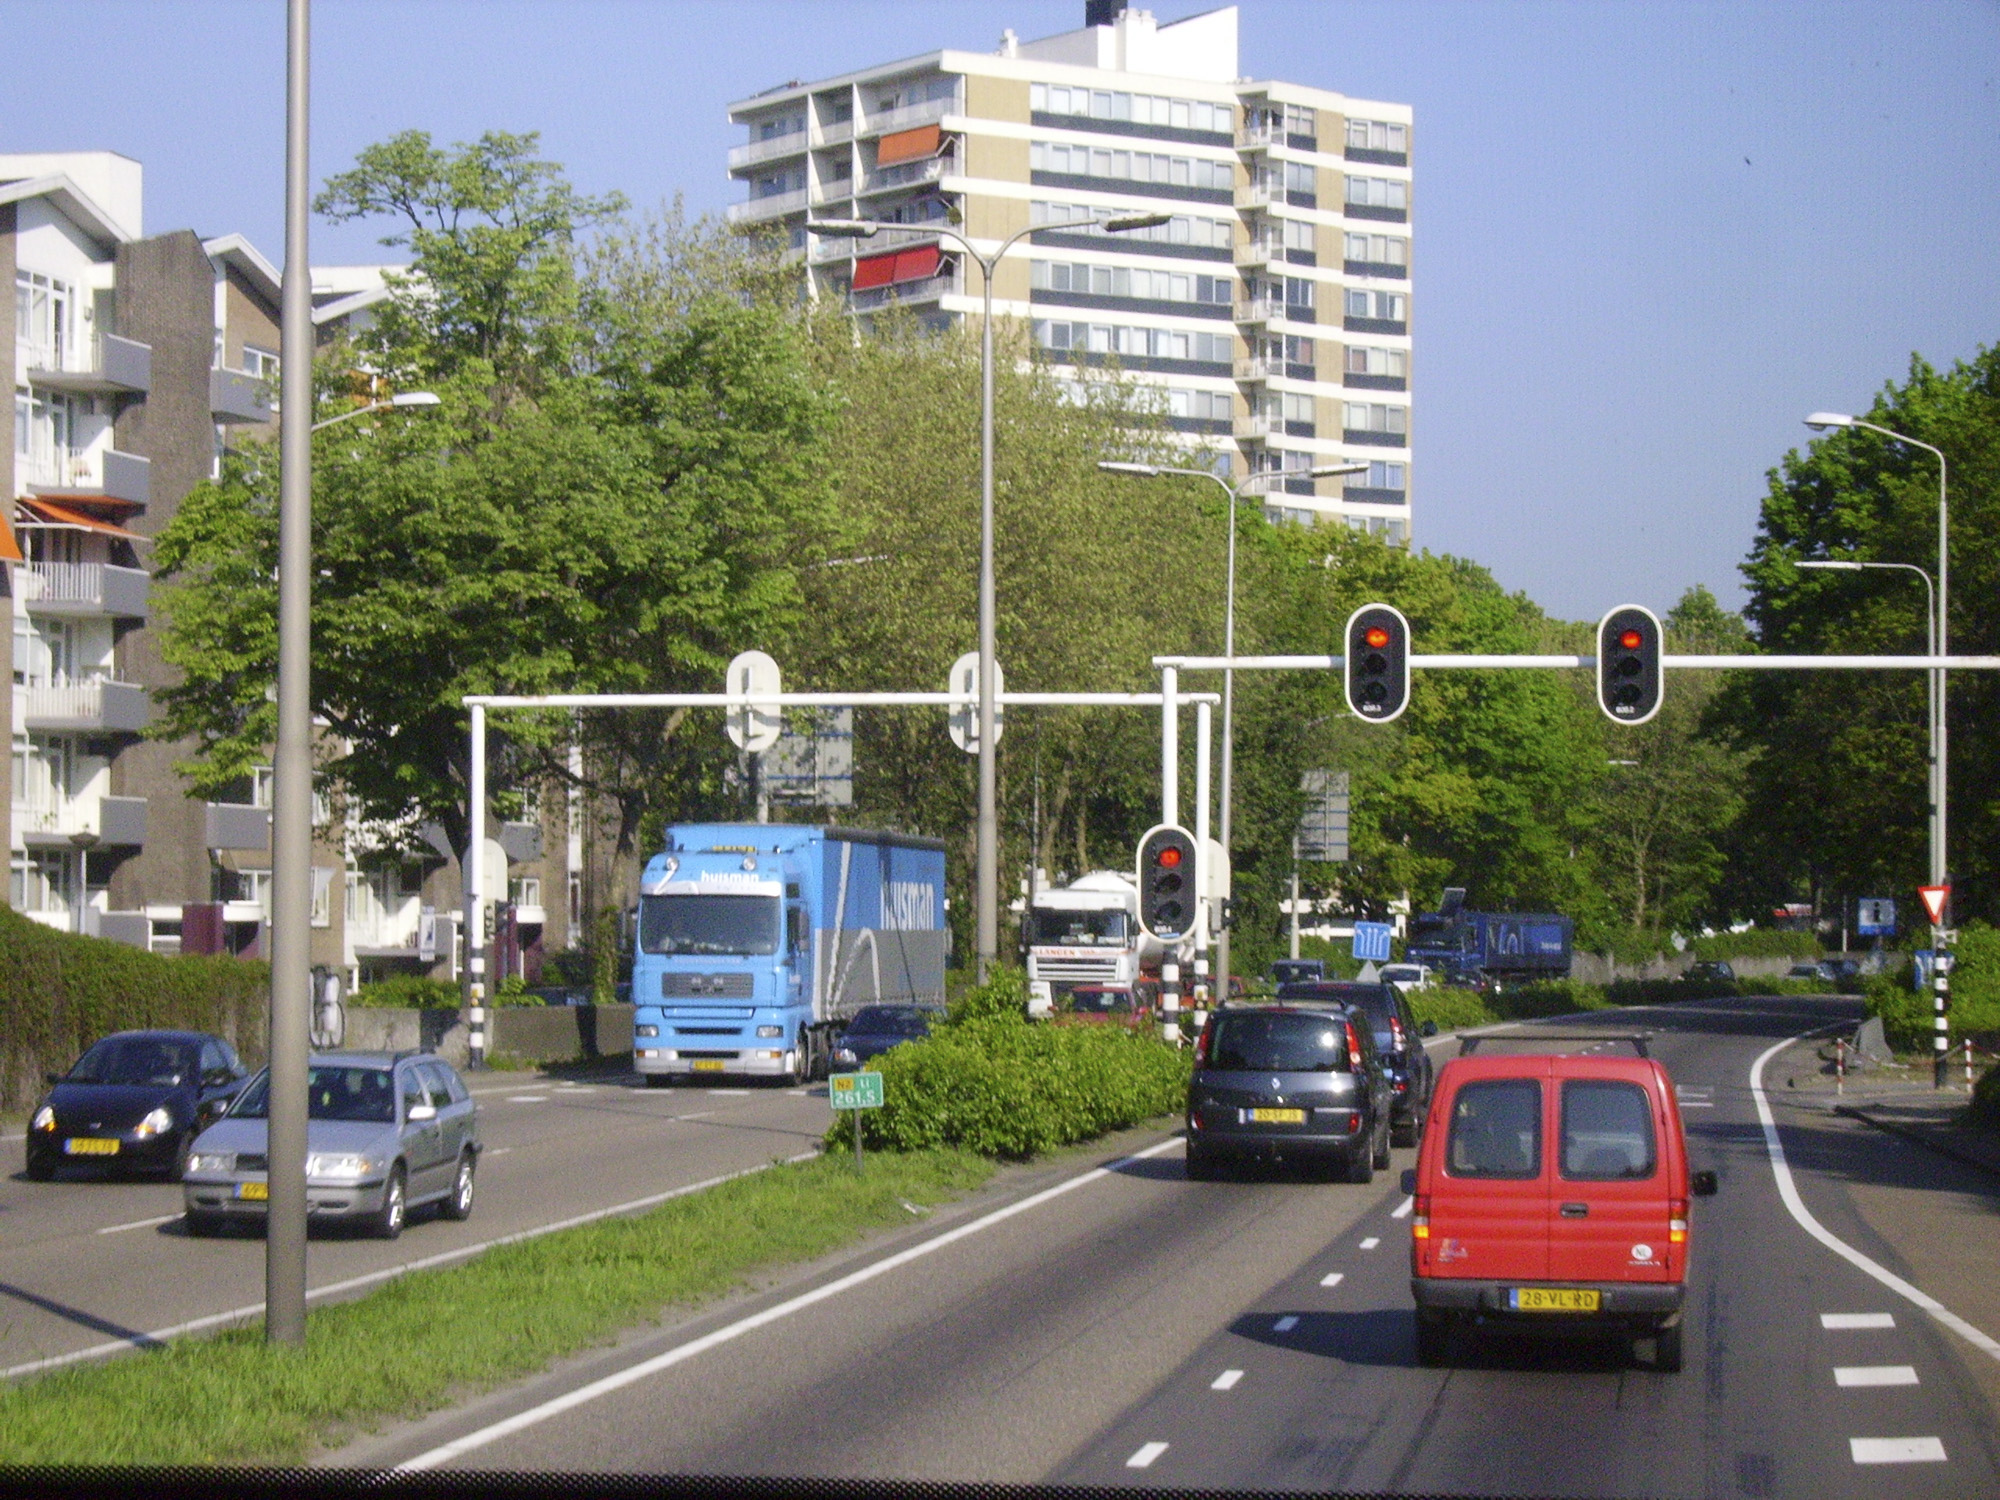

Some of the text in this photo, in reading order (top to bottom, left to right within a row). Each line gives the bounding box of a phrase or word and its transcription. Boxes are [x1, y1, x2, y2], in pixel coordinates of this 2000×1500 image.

[701, 869, 760, 883] huisman
[880, 881, 934, 931] huisman
[1523, 1290, 1595, 1308] 28-VL-RD
